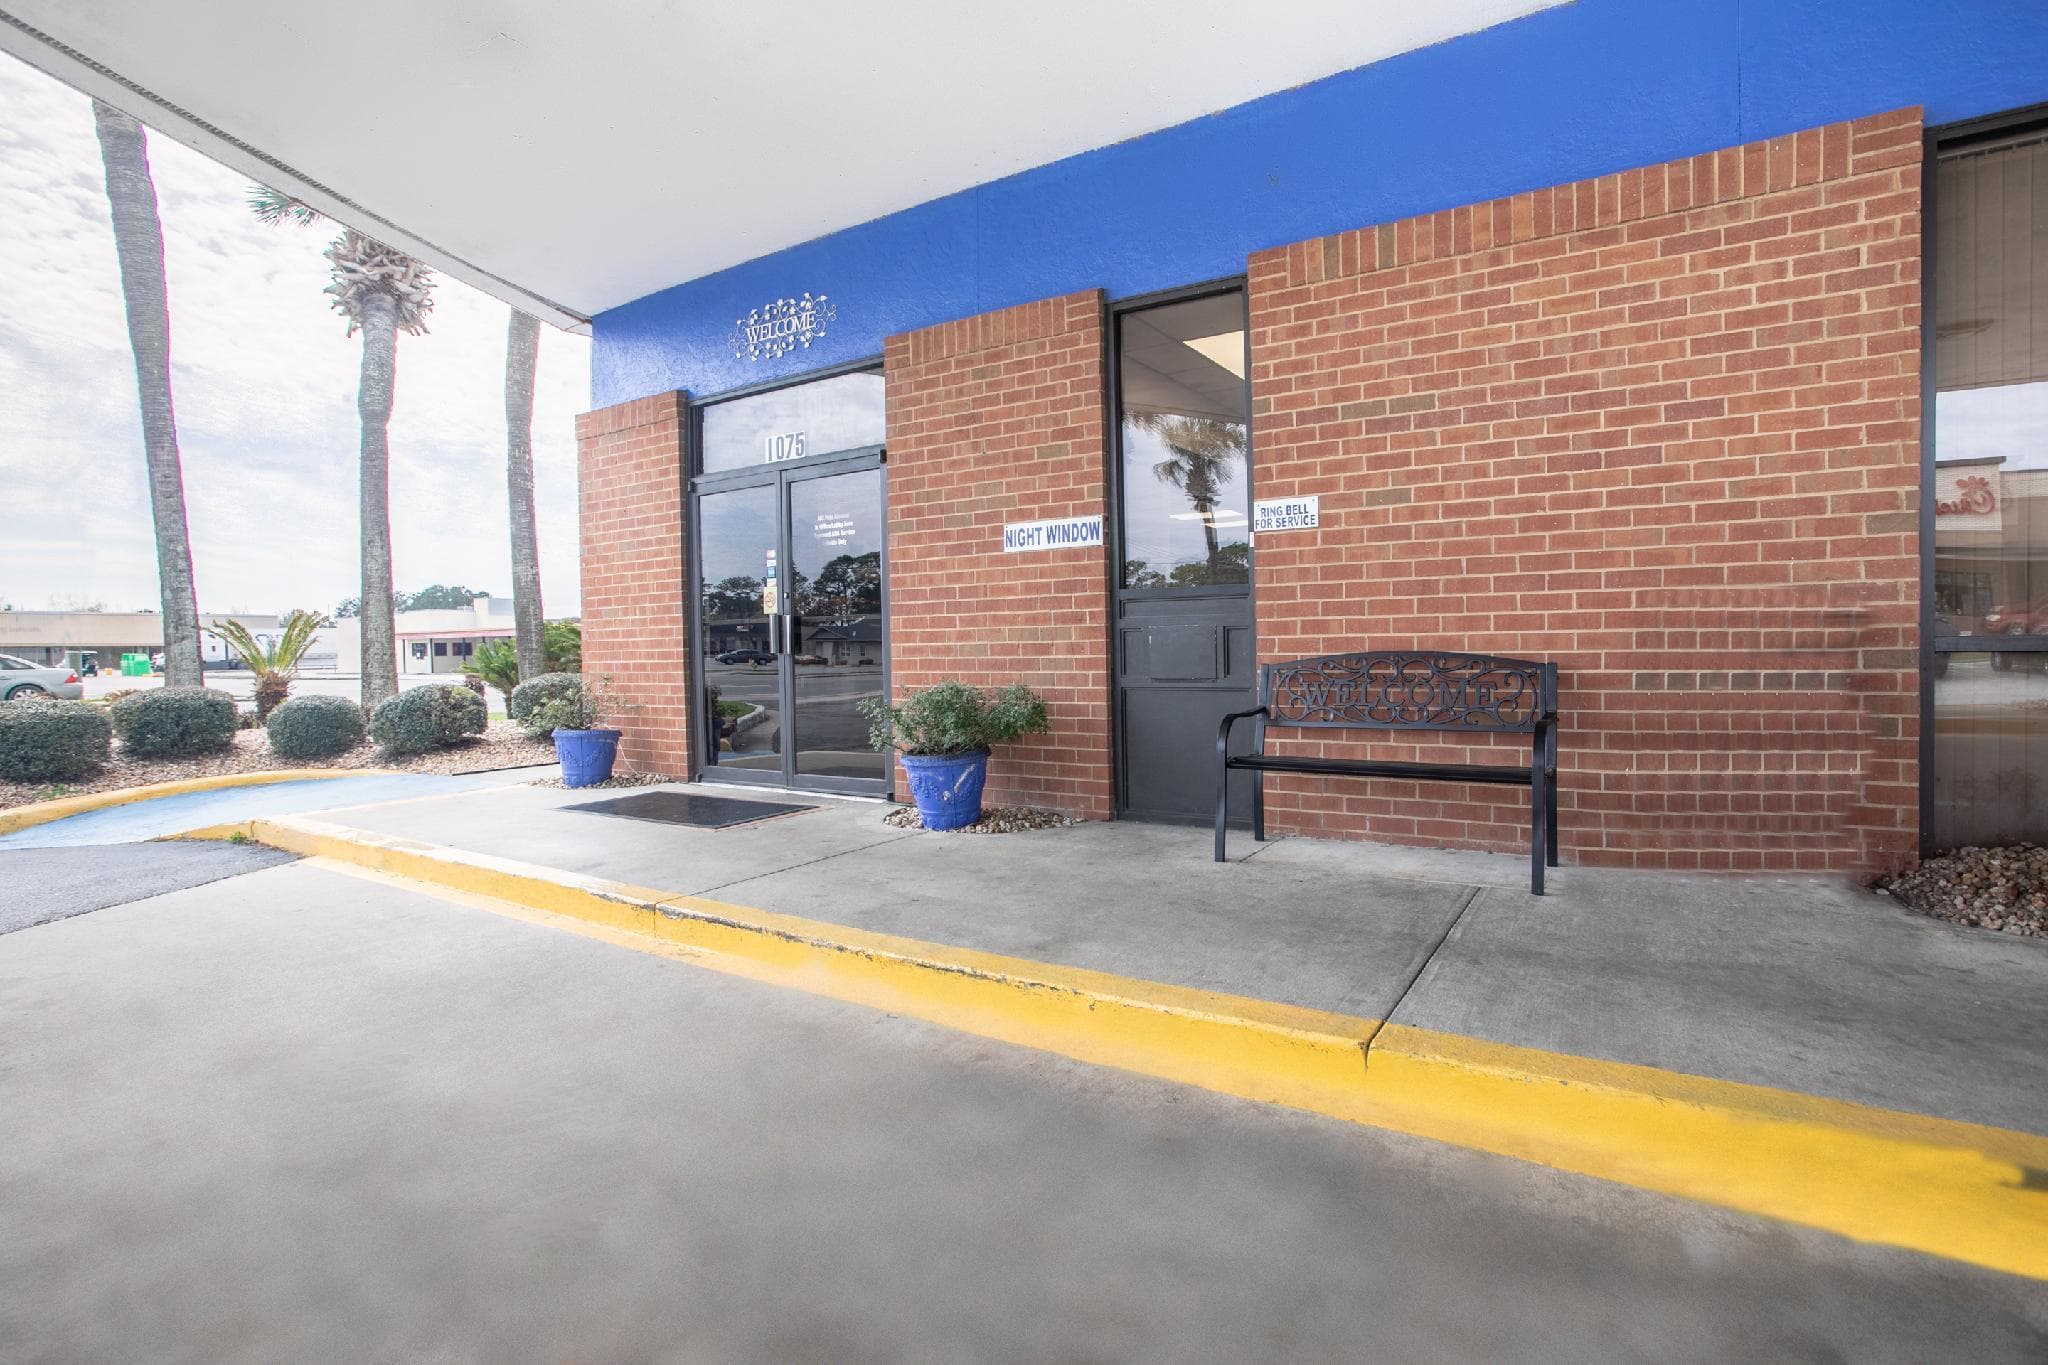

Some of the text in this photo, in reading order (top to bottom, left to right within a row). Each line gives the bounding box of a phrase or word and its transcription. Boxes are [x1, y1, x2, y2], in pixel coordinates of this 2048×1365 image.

[746, 311, 816, 343] WELCOME
[767, 432, 805, 462] 1075
[1255, 515, 1316, 529] FOR SERVICE
[1260, 504, 1309, 518] RING BELL
[1005, 521, 1101, 548] NIGHT WINDOW
[1302, 680, 1498, 709] WELCOME
